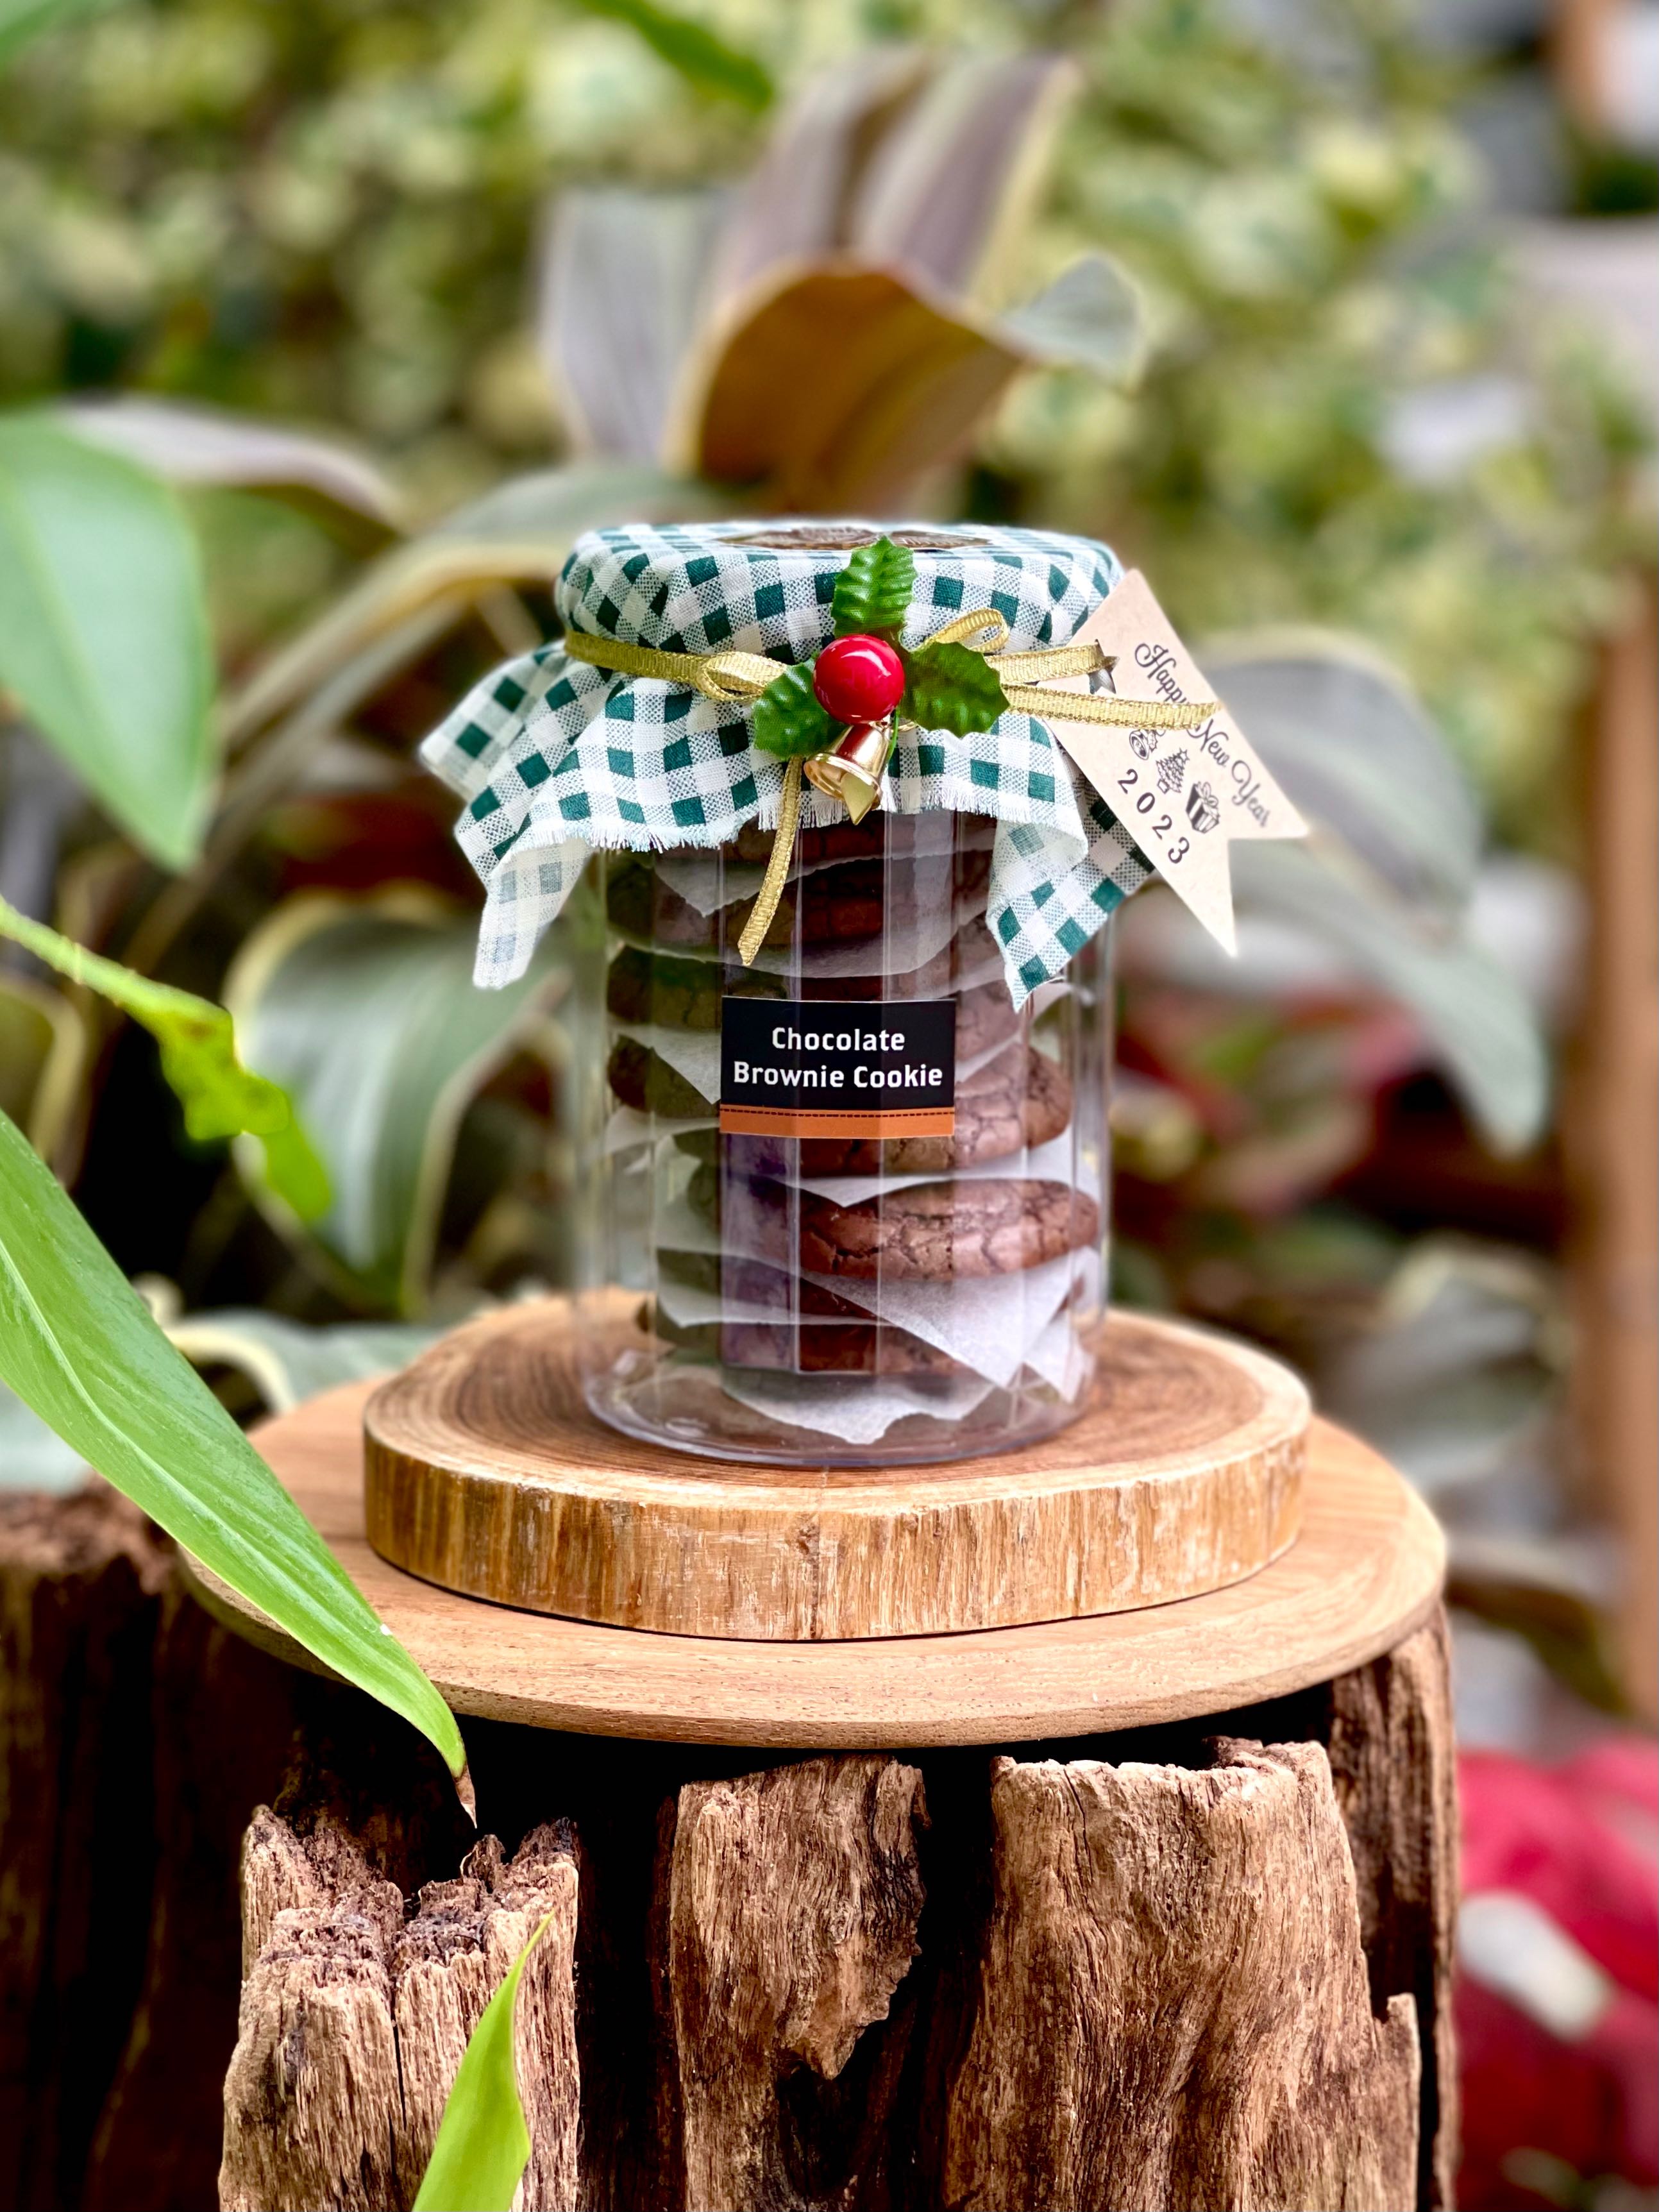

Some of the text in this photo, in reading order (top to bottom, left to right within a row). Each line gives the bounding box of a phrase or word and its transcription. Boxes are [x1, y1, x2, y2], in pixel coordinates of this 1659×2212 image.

[1186, 718, 1230, 768] New
[1231, 759, 1271, 828] Year
[1117, 768, 1190, 865] 2023
[772, 1027, 905, 1051] Chocolate
[734, 1061, 943, 1088] Brownie Cookie
